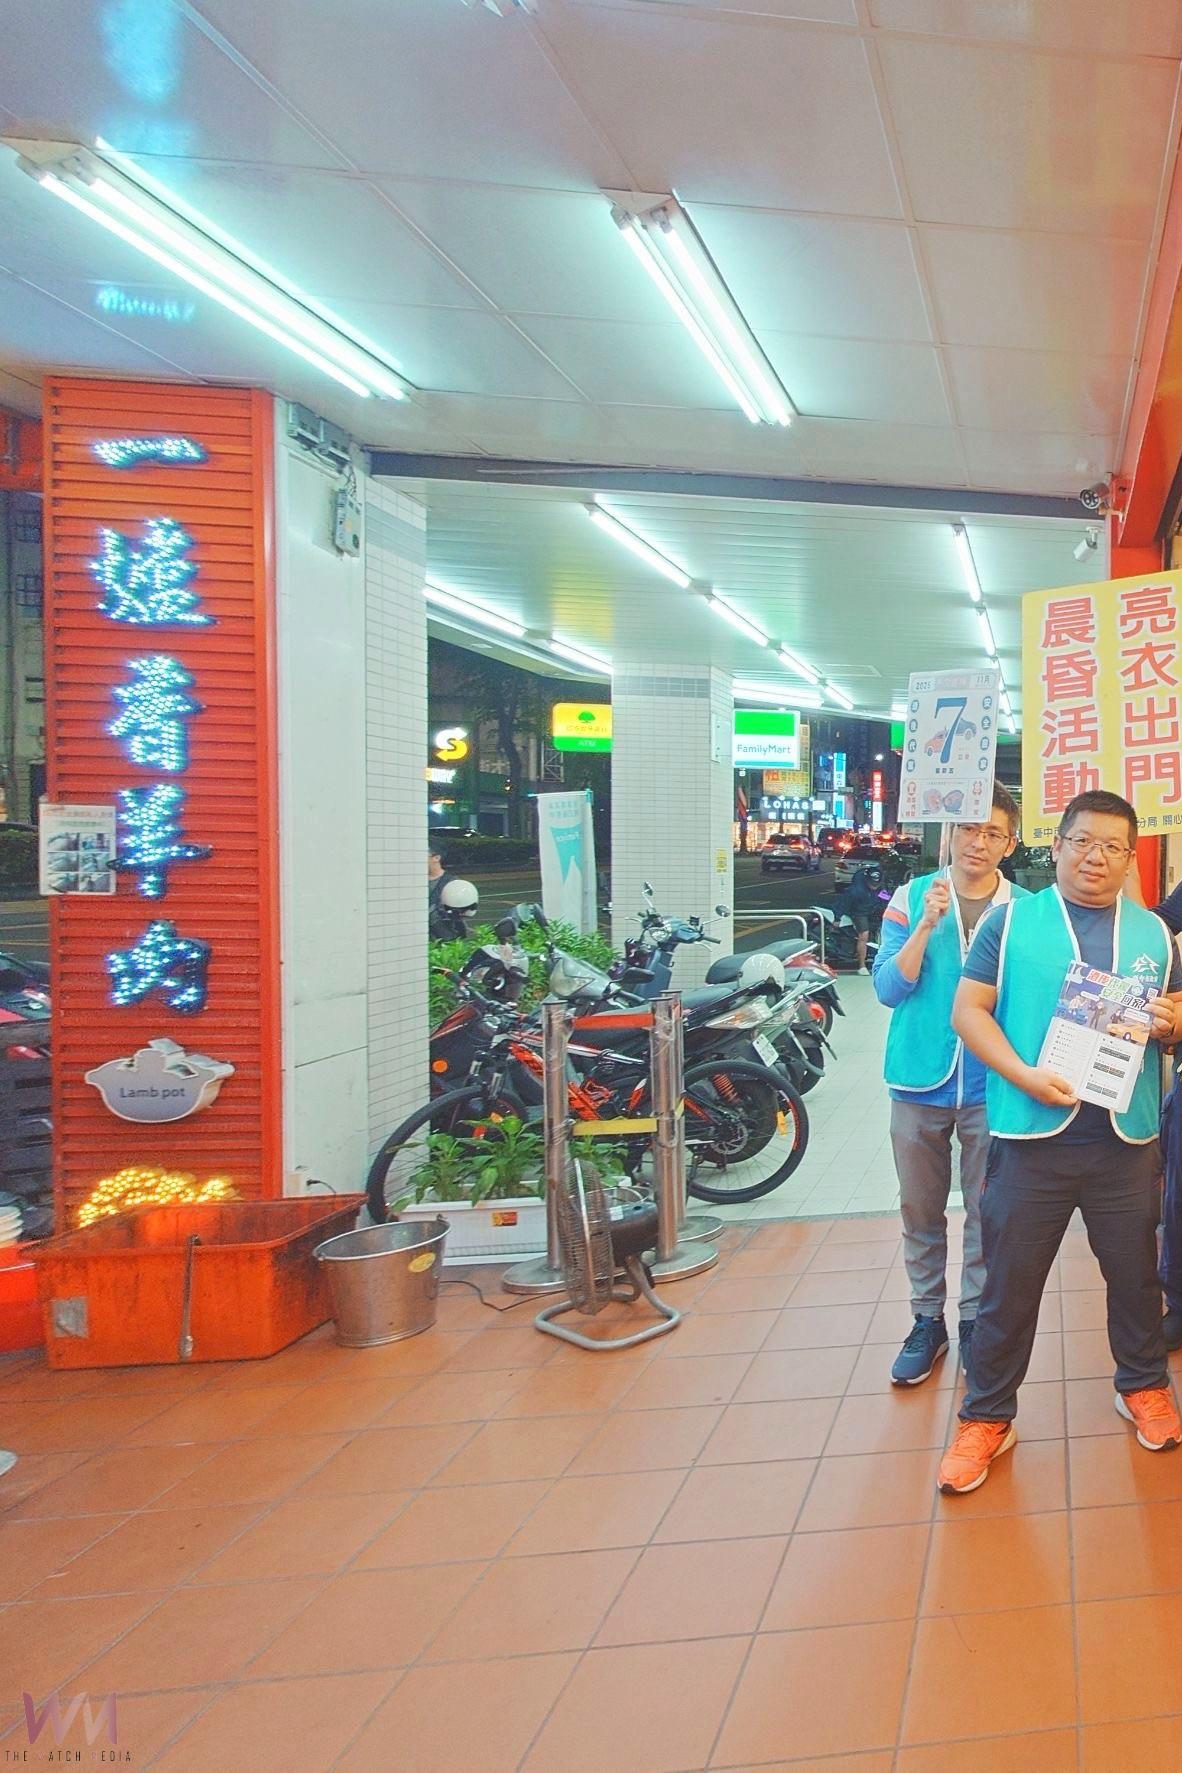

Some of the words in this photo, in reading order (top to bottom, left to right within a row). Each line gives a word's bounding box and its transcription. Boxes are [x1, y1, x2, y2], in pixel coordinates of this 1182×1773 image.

[1041, 596, 1100, 815] 晨昏活動
[1119, 586, 1182, 804] 亮衣出門
[736, 743, 792, 755] FamilyMart
[934, 697, 967, 764] 7
[763, 800, 809, 810] LOHAS
[119, 1086, 159, 1099] Lamb
[162, 1086, 186, 1102] pot
